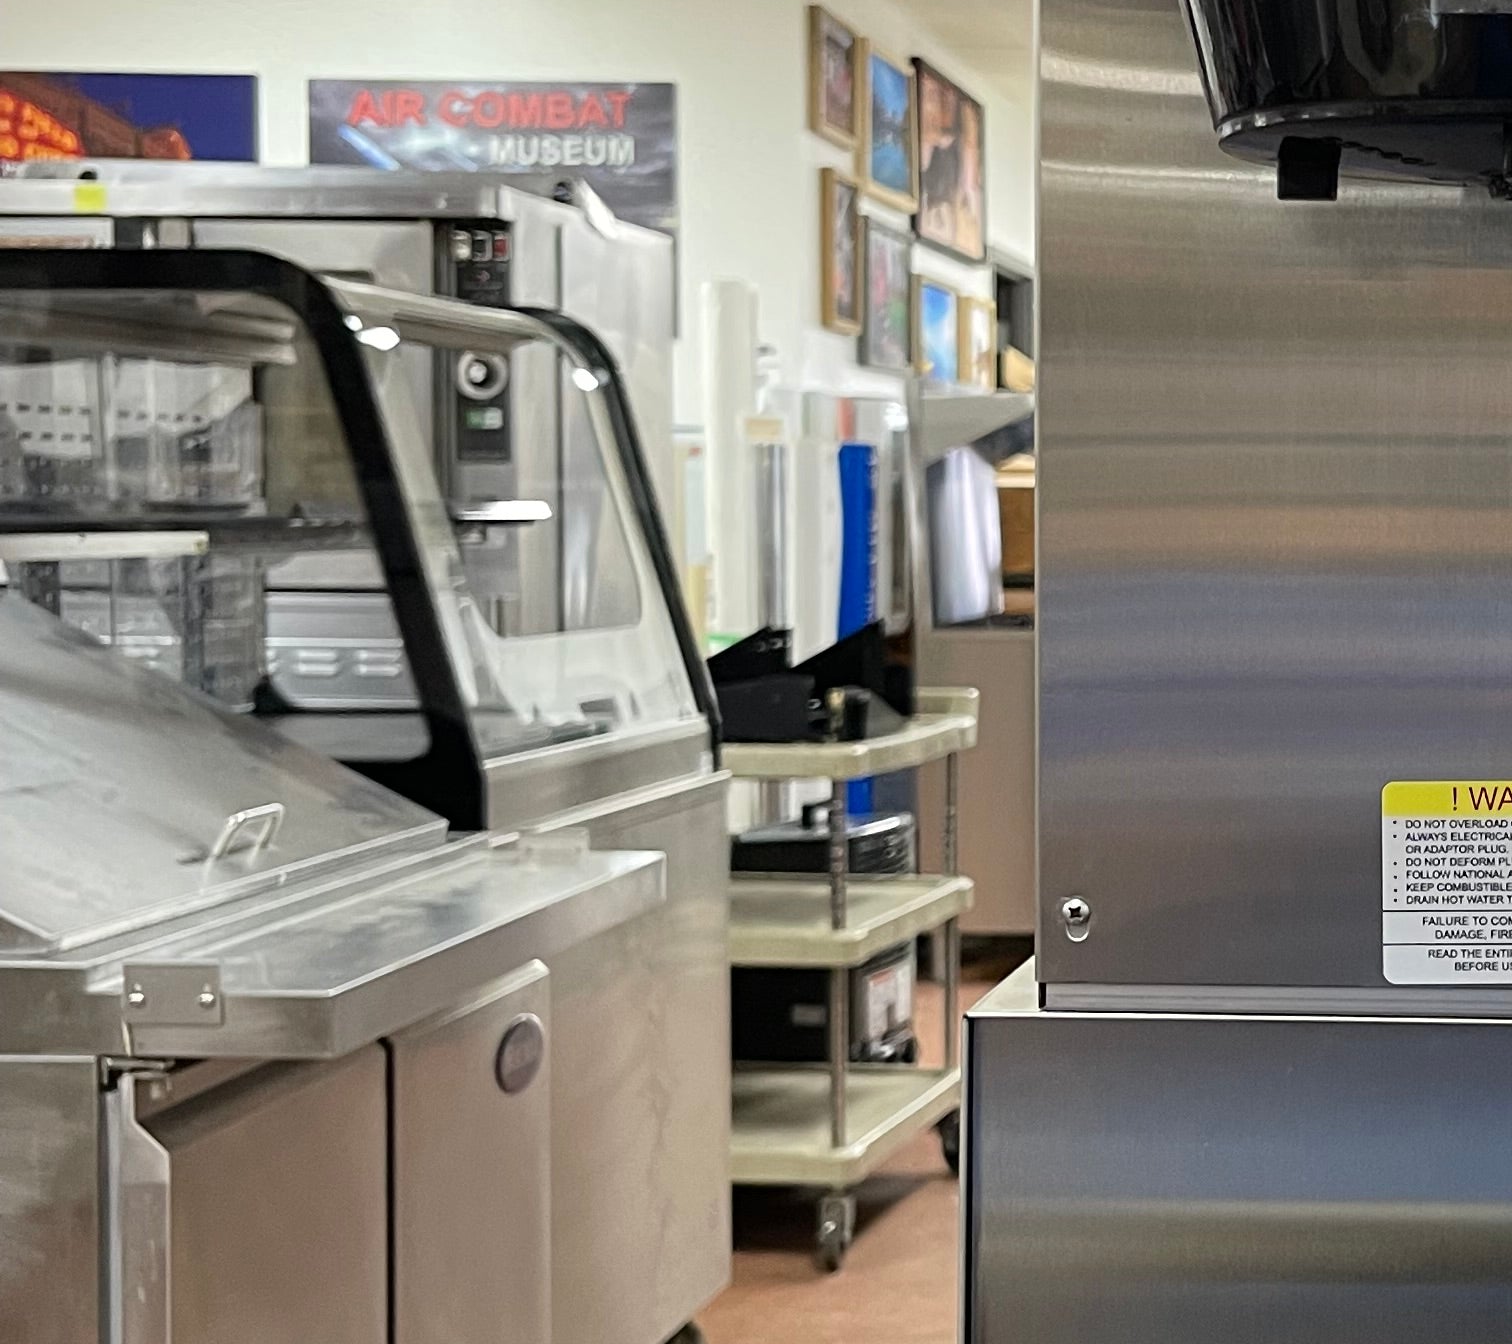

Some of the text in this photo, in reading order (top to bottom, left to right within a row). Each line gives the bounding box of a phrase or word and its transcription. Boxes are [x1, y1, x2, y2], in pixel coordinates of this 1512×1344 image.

[349, 89, 634, 129] AIR COMBAT
[489, 133, 635, 167] MUSEUM
[1405, 819, 1421, 829] DO
[1424, 819, 1446, 829] NOT
[1449, 819, 1508, 829] OVERLOAD
[1405, 832, 1447, 841] ALWAYS
[1405, 844, 1421, 854] OR
[1424, 844, 1474, 854] ADAPTOR
[1406, 857, 1421, 866] DO
[1424, 857, 1446, 866] NOT
[1450, 857, 1495, 866] DEFORM
[1406, 870, 1451, 879] FOLLOW
[1454, 870, 1504, 879] NATIONAL
[1406, 882, 1434, 892] KEEP
[1406, 895, 1439, 905] DRAIN
[1442, 895, 1464, 904] HOT
[1467, 894, 1504, 904] WATER
[1423, 916, 1469, 926] FAILURE
[1472, 916, 1488, 926] TO
[1435, 929, 1487, 940] DAMAGE,
[1428, 949, 1458, 958] READ
[1461, 949, 1482, 958] THE
[1454, 962, 1498, 971] BEFORE
